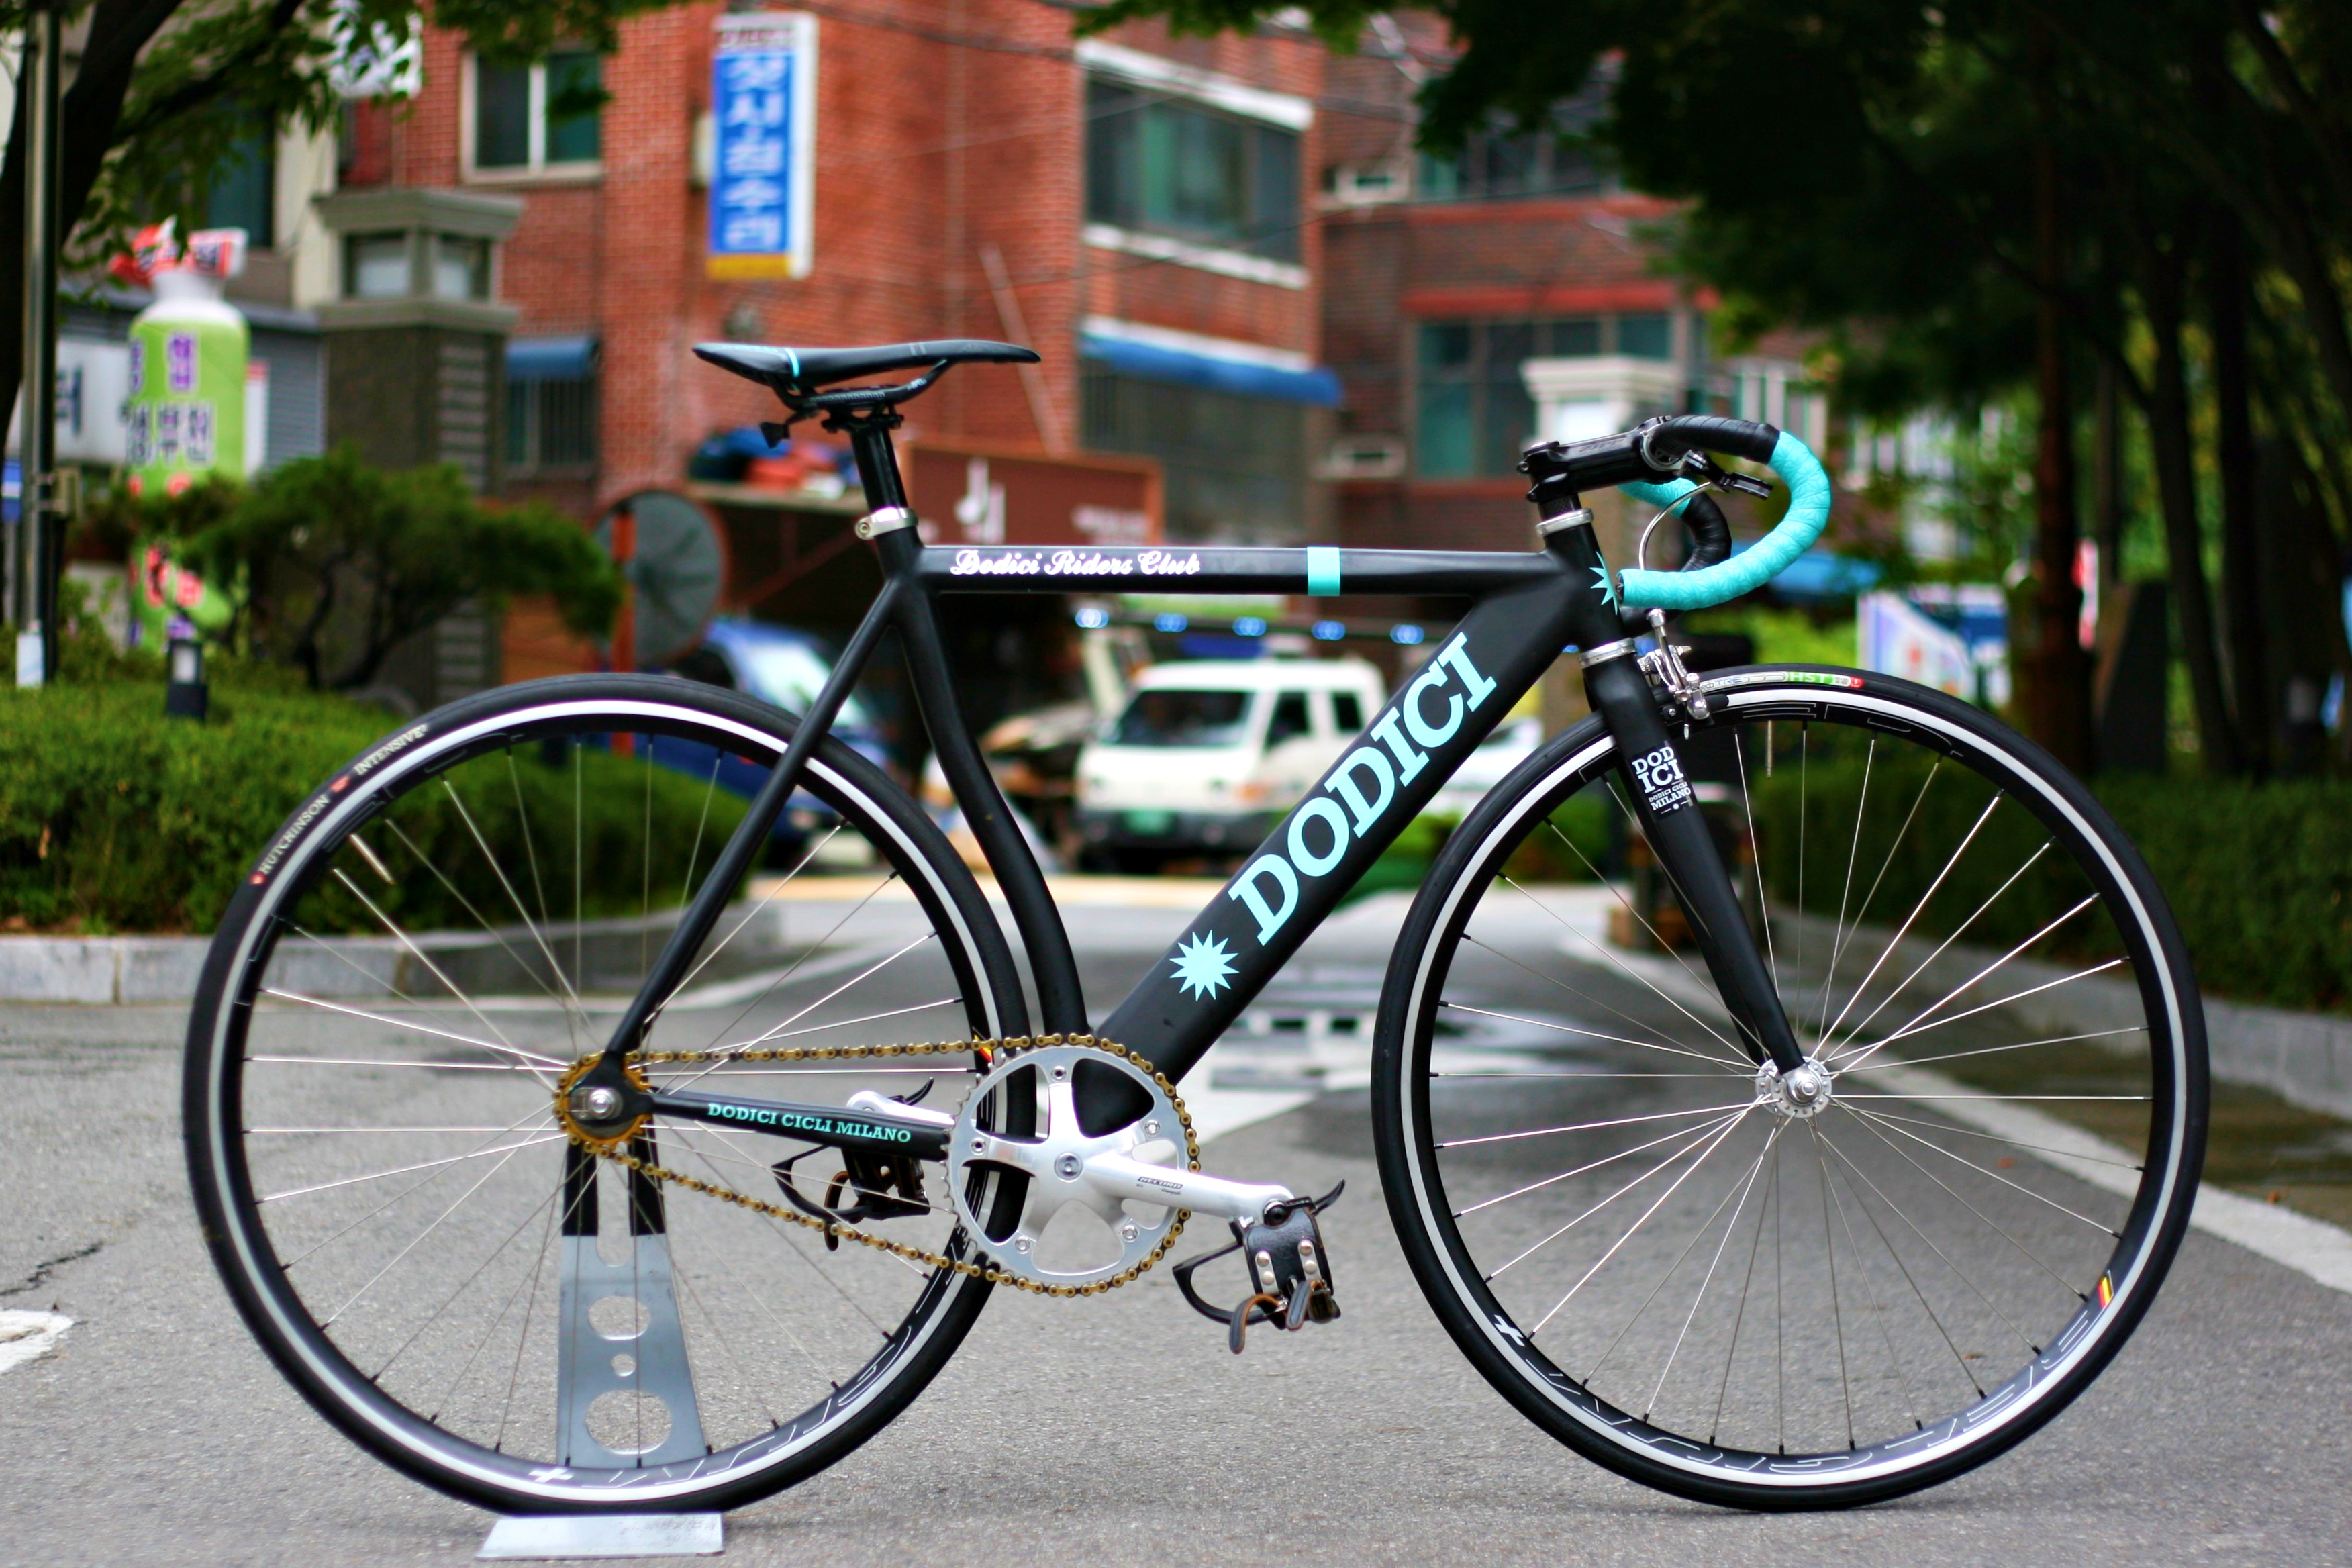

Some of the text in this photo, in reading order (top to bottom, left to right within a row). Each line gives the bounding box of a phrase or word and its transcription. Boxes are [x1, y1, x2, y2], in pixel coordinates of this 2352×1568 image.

[950, 549, 1201, 575] Dodici Riders Club
[1790, 671, 1828, 685] HST
[1632, 746, 1675, 775] DOD
[1228, 632, 1497, 946] DODICI
[1638, 758, 1684, 793] ICI
[1648, 781, 1688, 803] DODICI CICLI
[1650, 787, 1692, 811] MILANO
[258, 793, 330, 875] HUTCHINSON
[707, 1103, 912, 1143] DODICI CICLI MILANO
